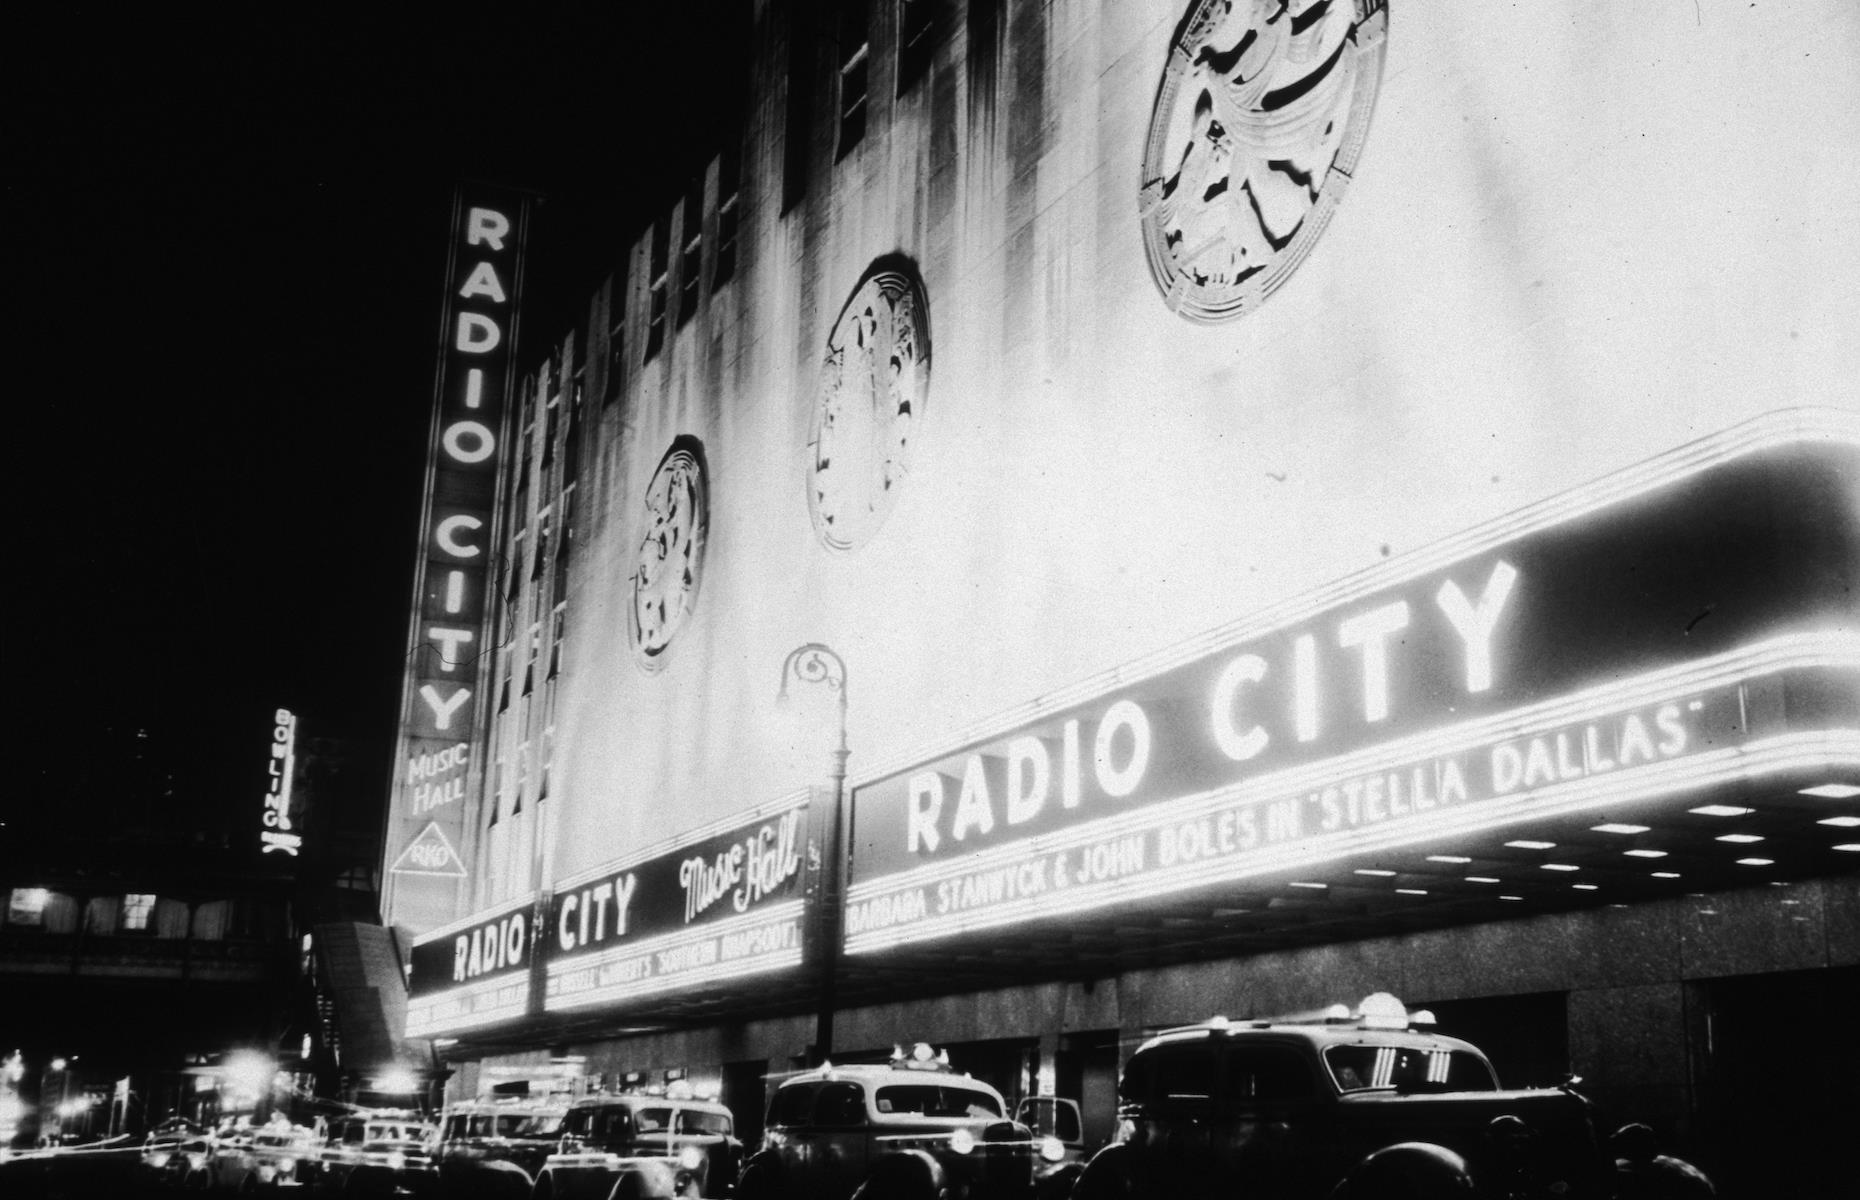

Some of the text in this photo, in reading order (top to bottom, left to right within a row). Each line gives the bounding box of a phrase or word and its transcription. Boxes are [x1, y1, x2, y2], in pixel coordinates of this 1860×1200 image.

[443, 207, 509, 463] RADIO
[419, 514, 483, 730] CITY
[408, 742, 468, 785] MUSIC
[908, 559, 1517, 854] RADIO CITY
[262, 708, 291, 827] BOWLING
[412, 777, 464, 816] HALL
[680, 808, 802, 924] Music Hall
[937, 858, 1047, 914] STANWYCK
[1076, 835, 1145, 884] JOHN
[1159, 808, 1256, 866] BOLES
[1267, 799, 1303, 842] IN
[453, 913, 525, 982] RADIO
[559, 872, 636, 951] CITY
